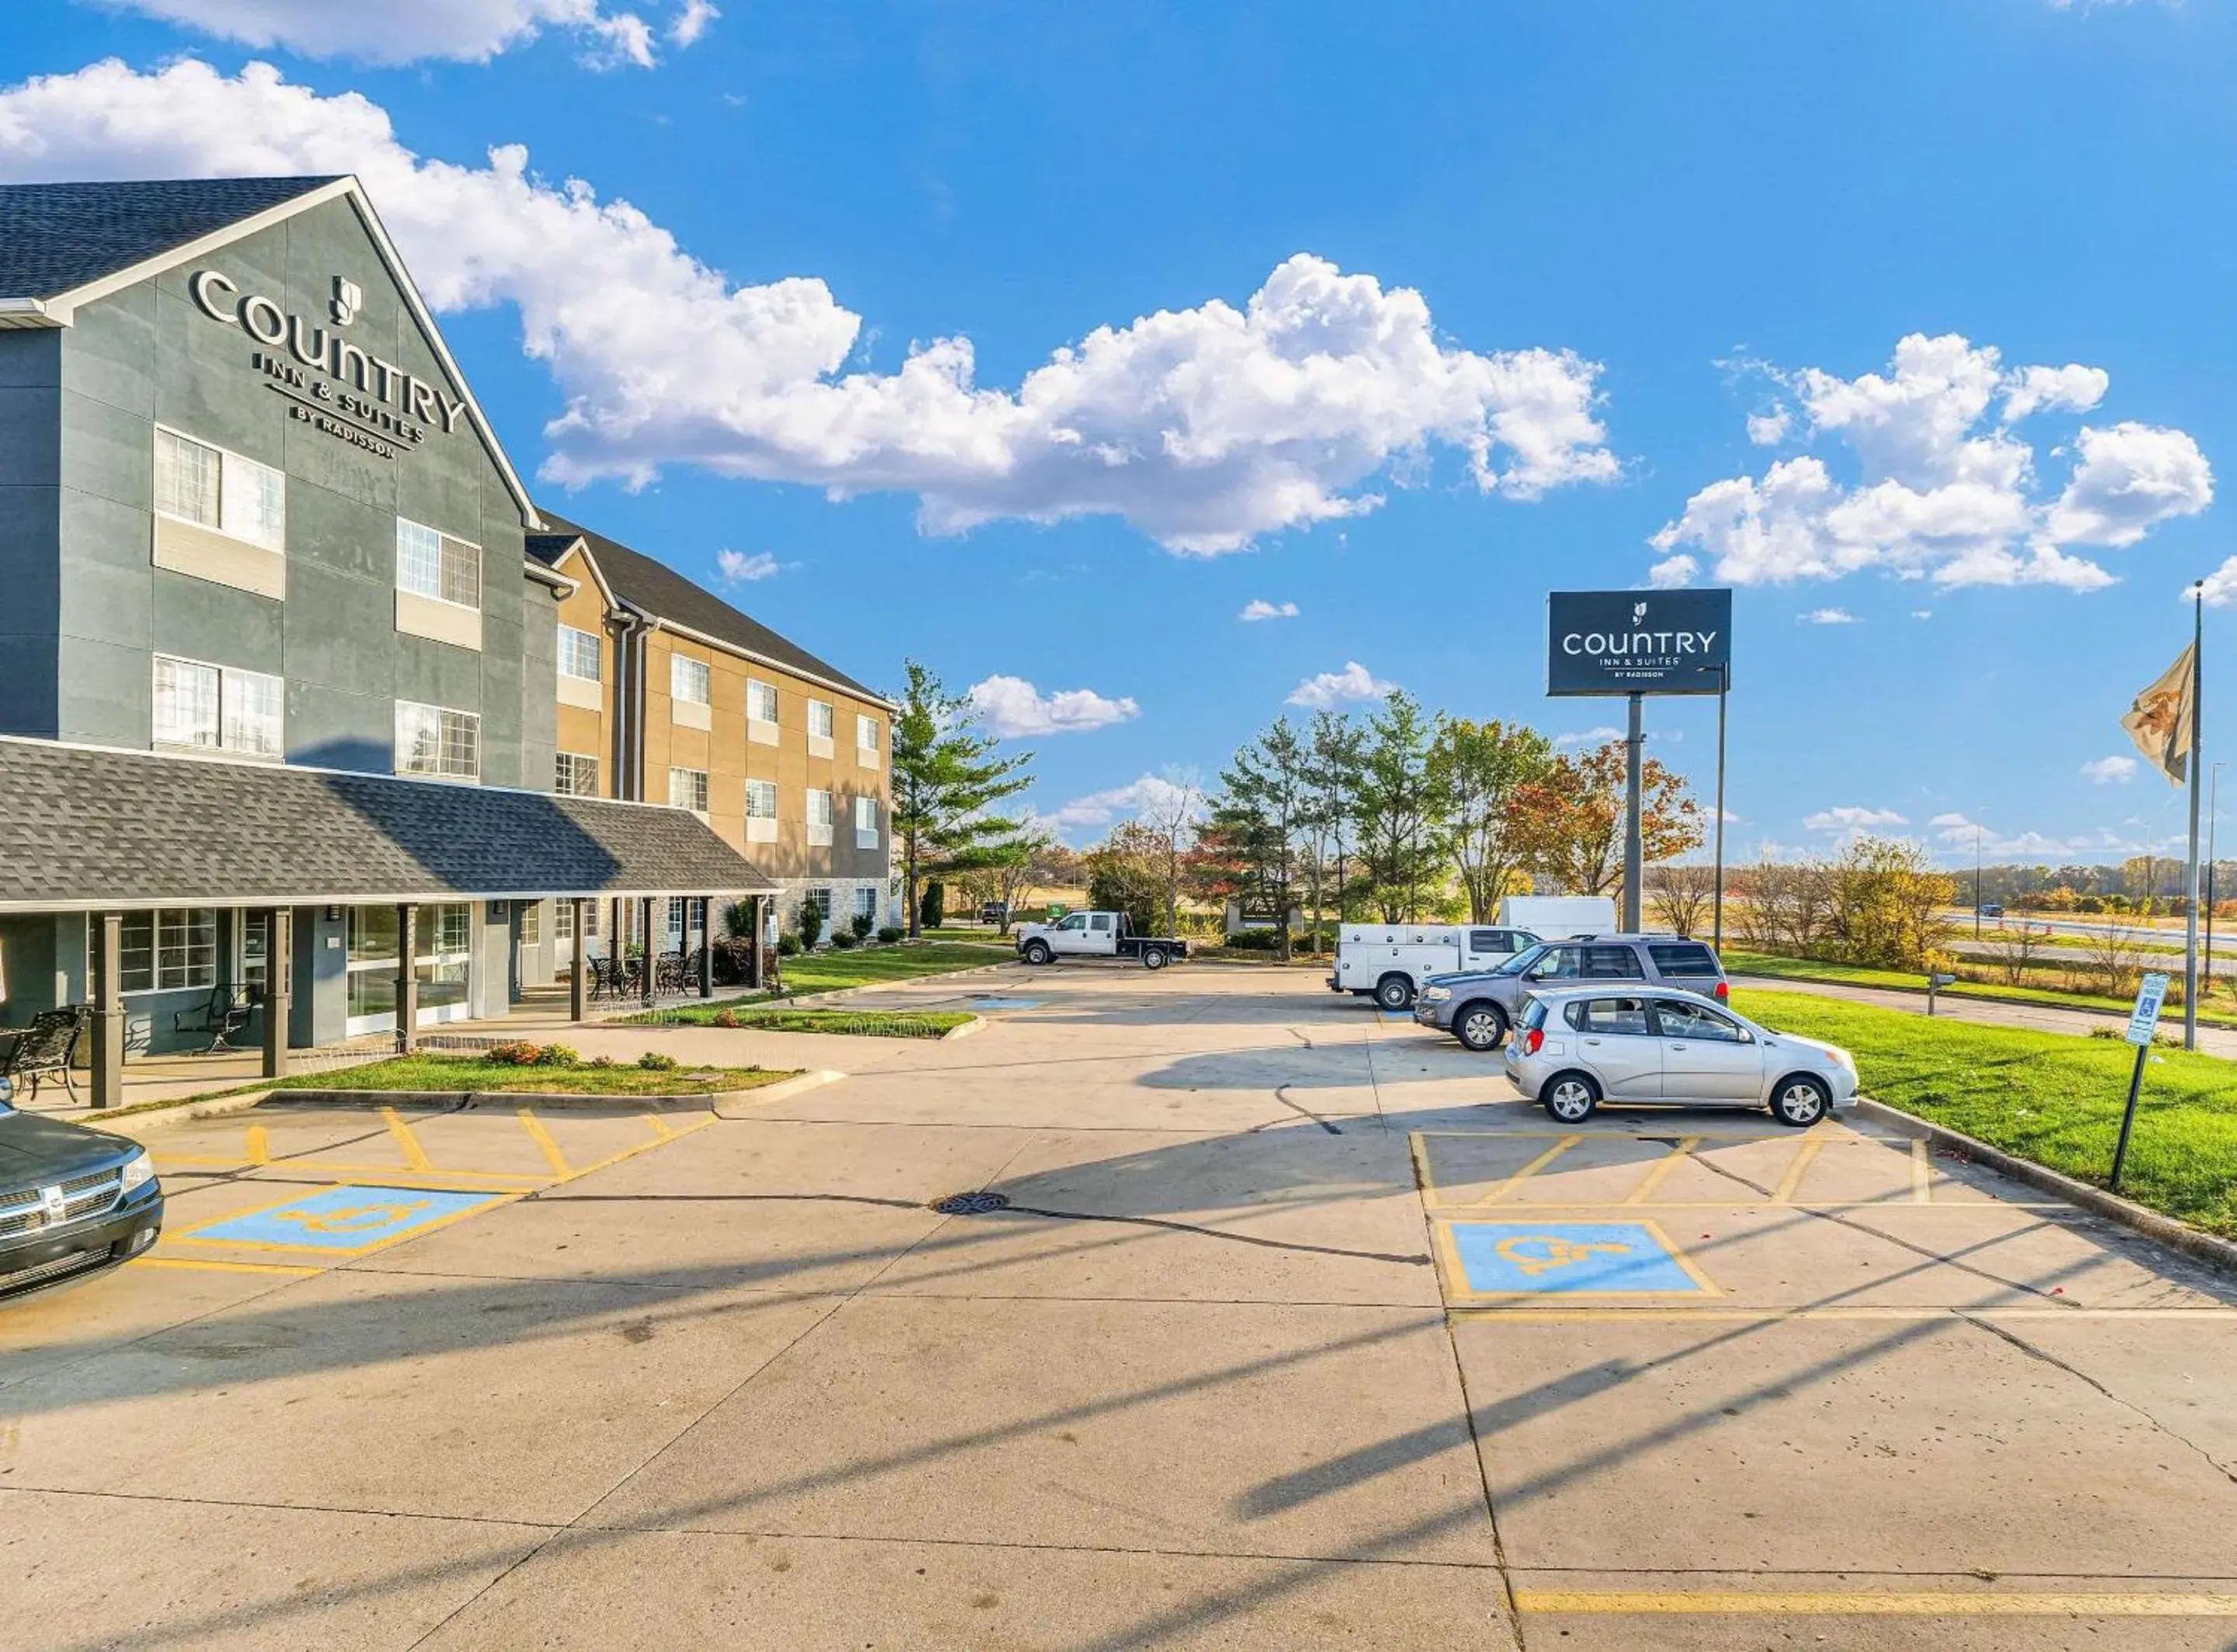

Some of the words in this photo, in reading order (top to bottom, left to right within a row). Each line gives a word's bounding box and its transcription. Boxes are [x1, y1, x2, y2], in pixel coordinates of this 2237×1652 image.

[256, 352, 305, 388] INN
[317, 381, 332, 401] &
[340, 394, 425, 444] SUITES
[295, 406, 315, 423] BY
[320, 418, 395, 460] RADISSON
[1637, 657, 1679, 666] SUITES
